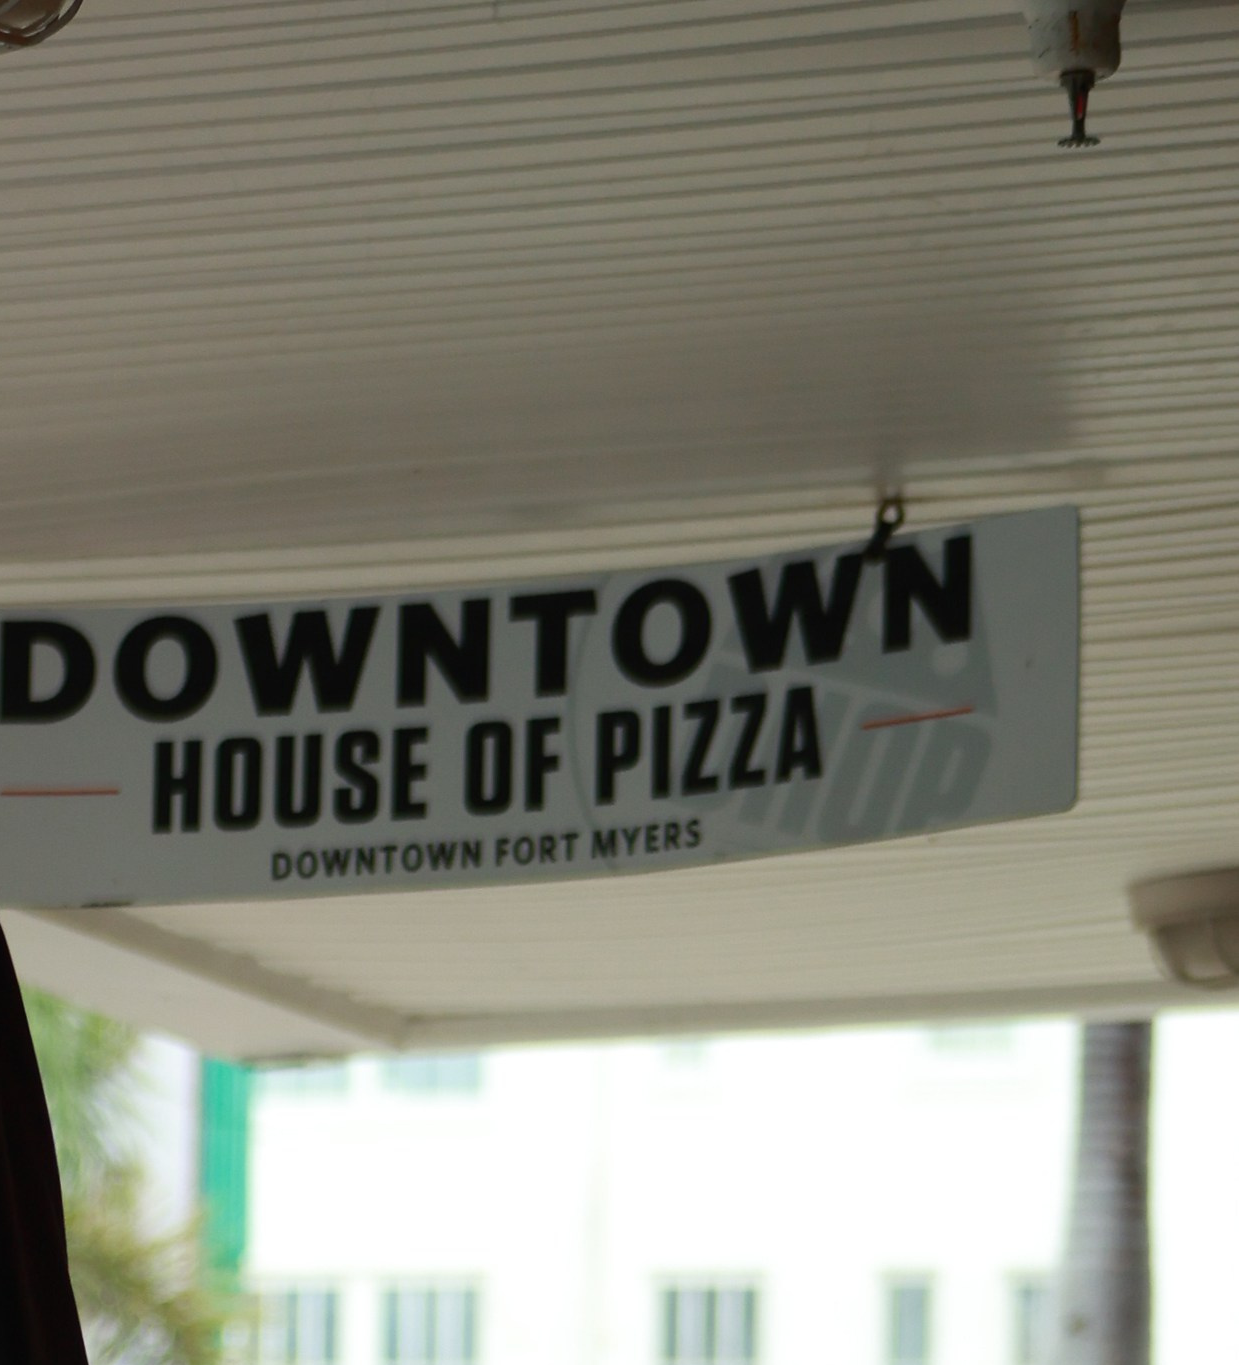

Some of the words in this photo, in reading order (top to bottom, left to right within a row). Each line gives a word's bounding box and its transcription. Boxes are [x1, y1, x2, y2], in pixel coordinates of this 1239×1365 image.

[152, 727, 431, 834] HOUSE
[463, 714, 562, 817] OF
[594, 683, 824, 806] PIZZA
[271, 836, 482, 881] DOWNTOWN
[494, 831, 580, 867] FORT
[591, 818, 702, 859] MYERS
